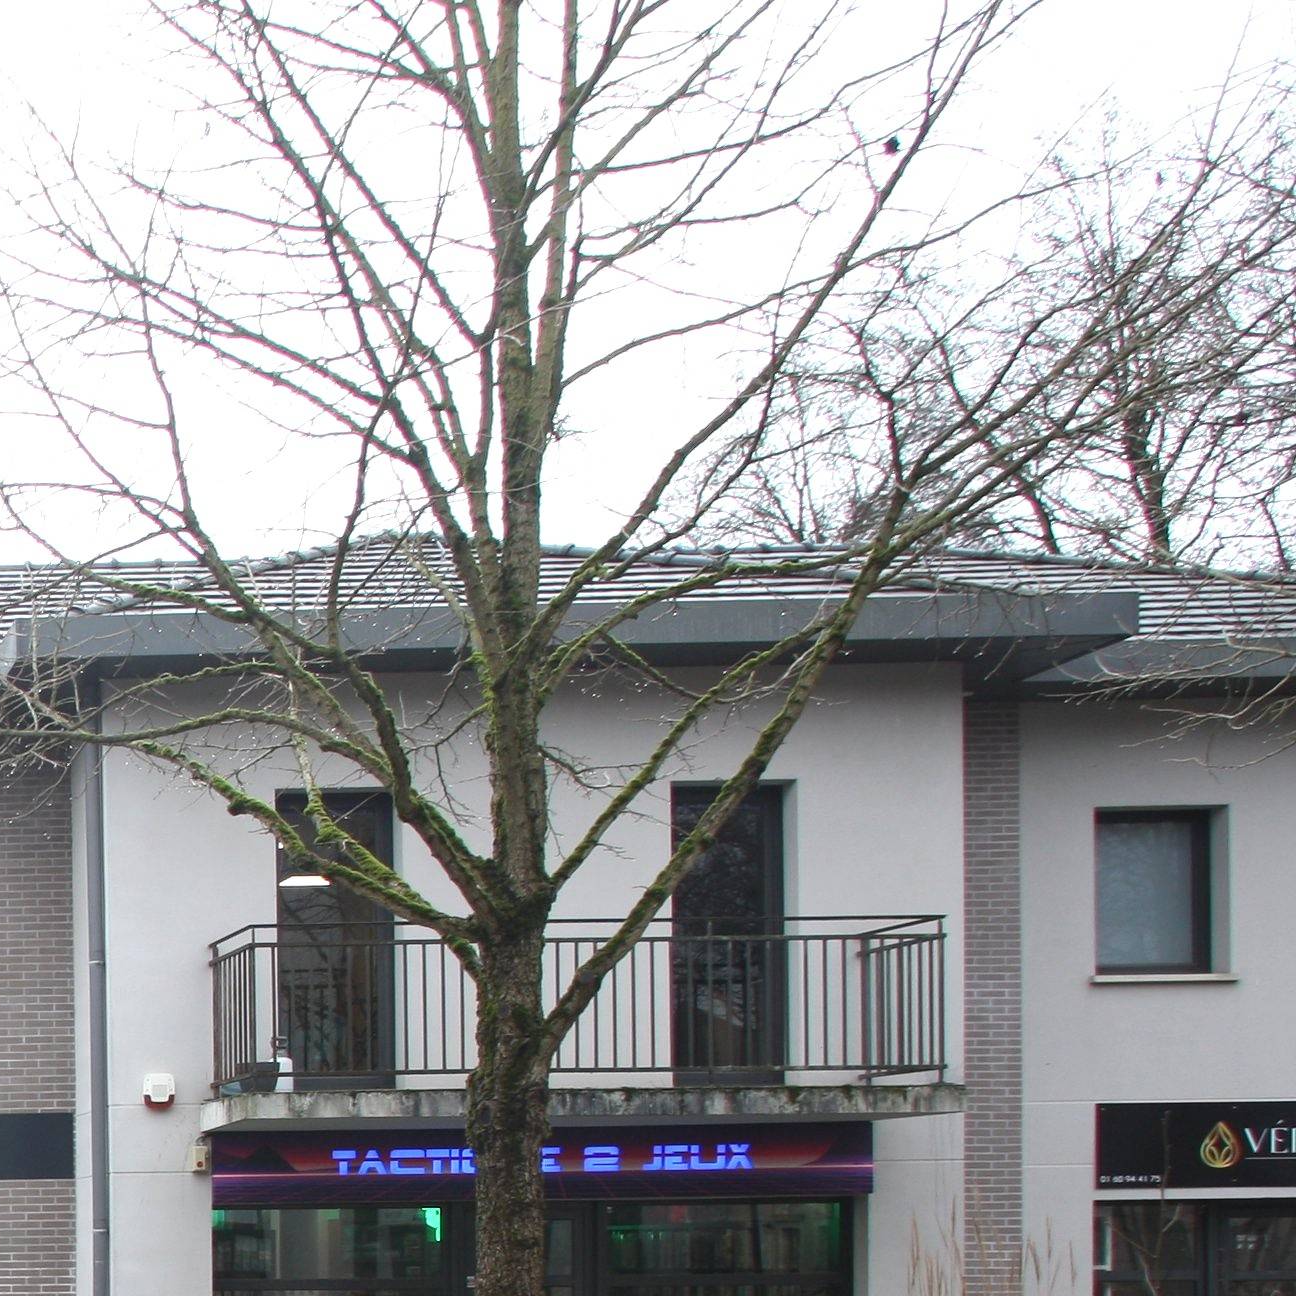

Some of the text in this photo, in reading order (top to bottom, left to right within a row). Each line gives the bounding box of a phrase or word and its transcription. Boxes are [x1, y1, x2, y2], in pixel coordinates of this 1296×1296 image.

[1244, 1119, 1296, 1154] VÉ
[331, 1143, 753, 1175] TACTIE 2 JEUX
